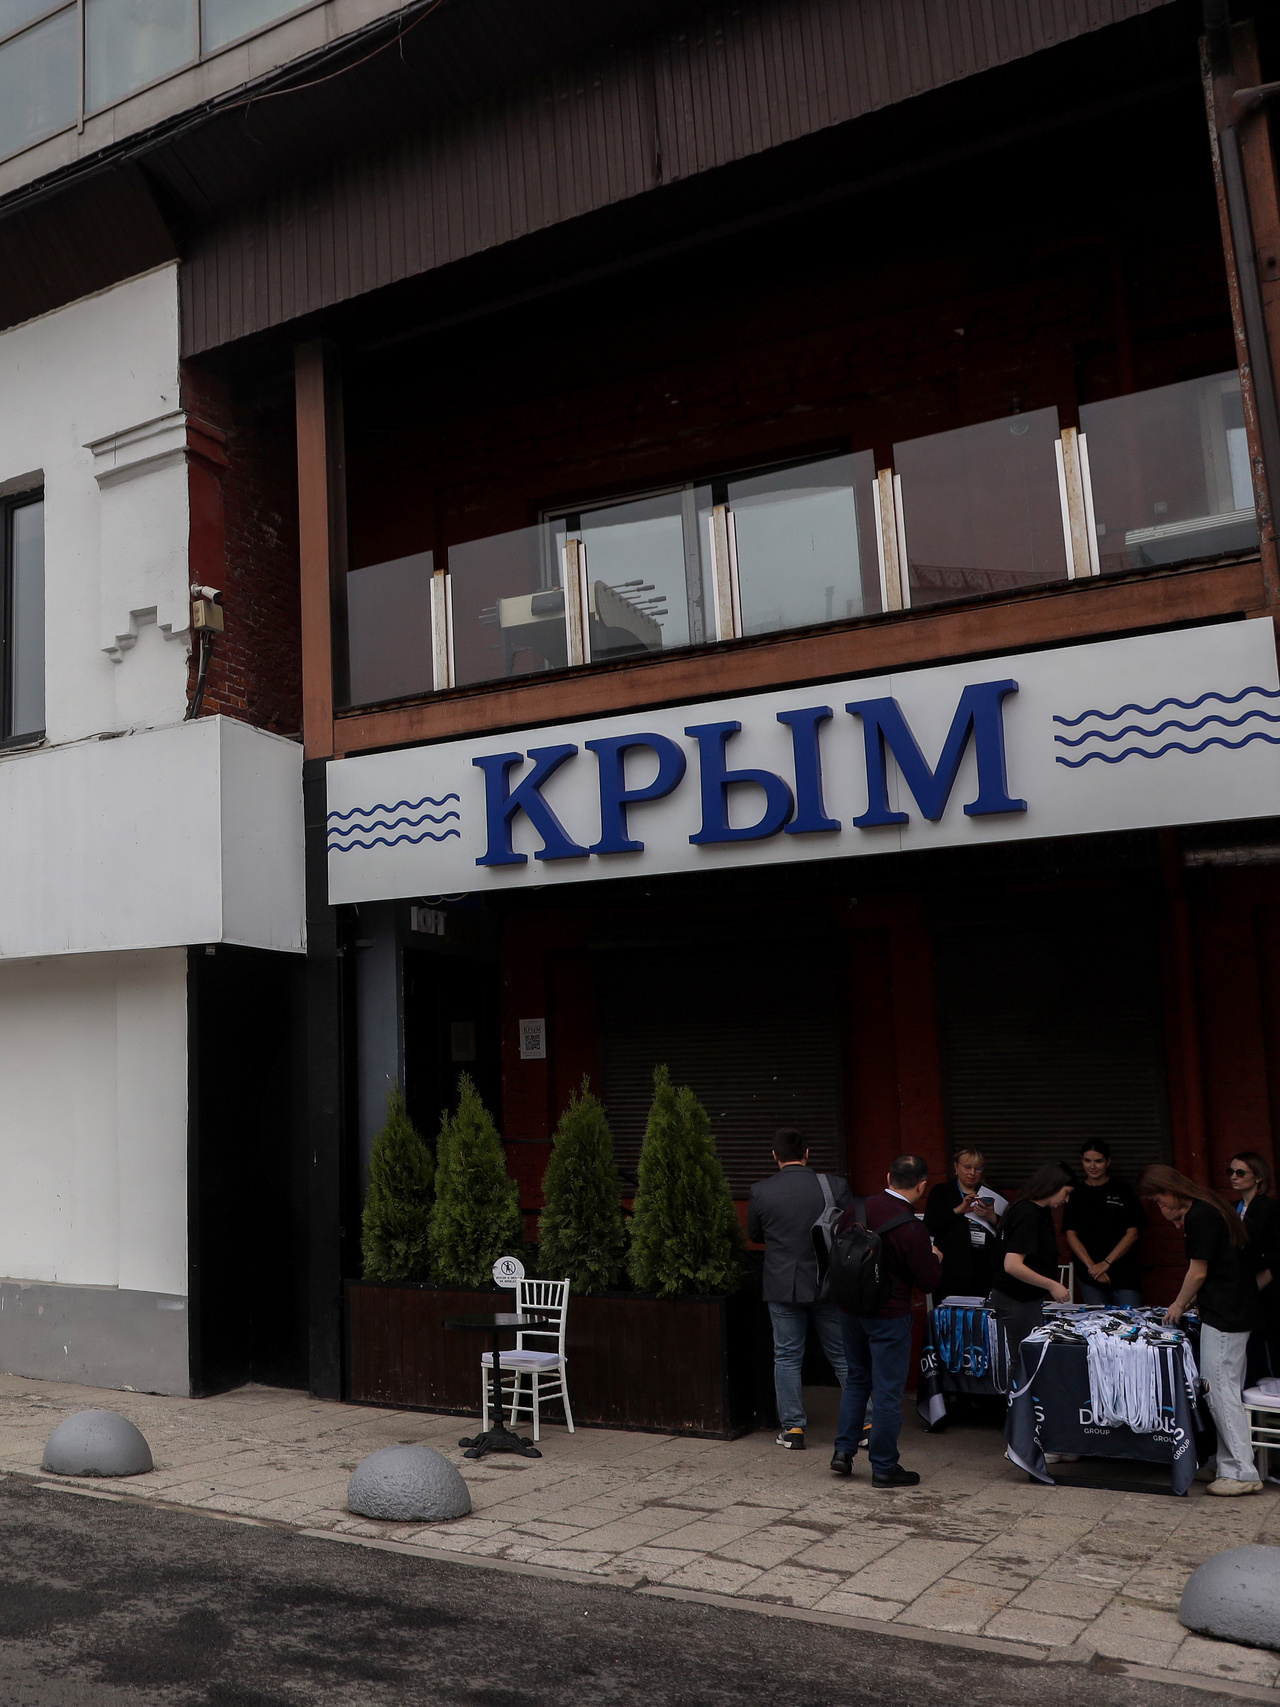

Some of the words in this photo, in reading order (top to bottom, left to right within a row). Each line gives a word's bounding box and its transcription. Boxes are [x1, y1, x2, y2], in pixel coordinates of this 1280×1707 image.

[472, 679, 1028, 867] КРЫМ
[1083, 1427, 1111, 1436] GROUP
[1173, 1438, 1191, 1461] GROUP
